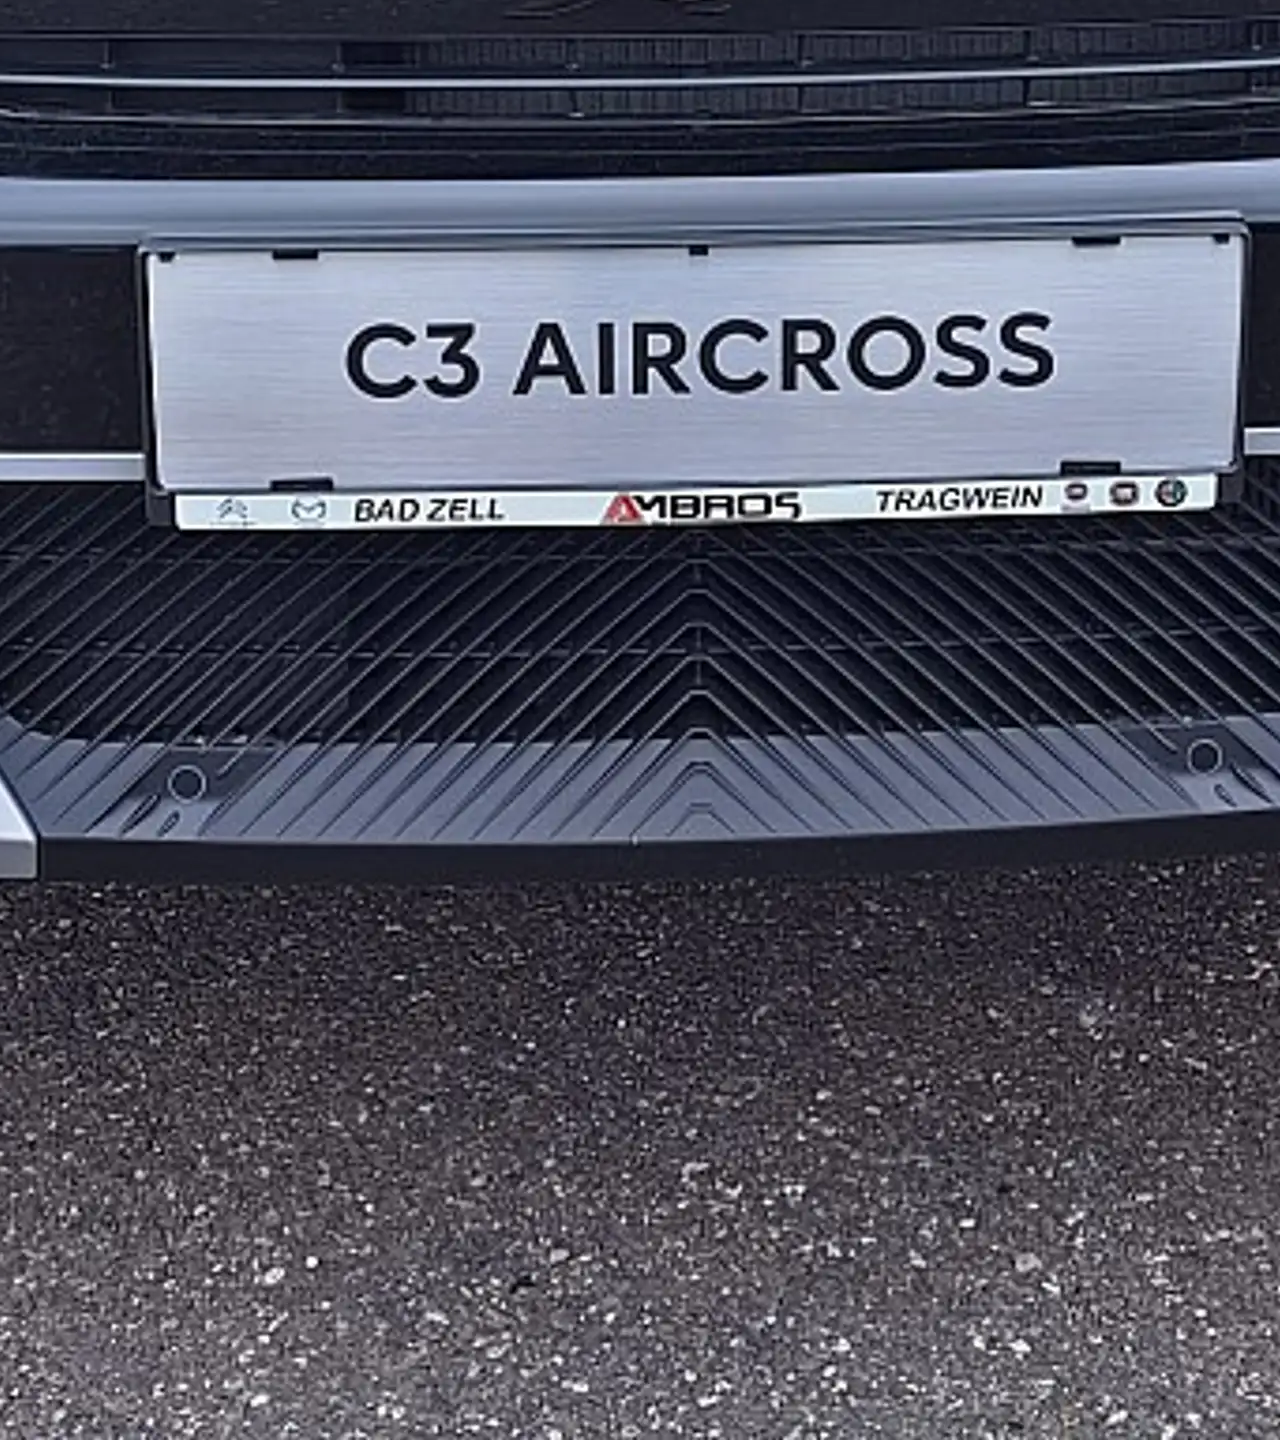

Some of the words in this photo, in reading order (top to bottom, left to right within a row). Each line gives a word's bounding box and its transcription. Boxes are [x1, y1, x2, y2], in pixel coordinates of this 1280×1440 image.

[347, 323, 479, 398] C3
[513, 313, 1053, 395] AIRCROSS
[355, 499, 419, 522] BAD
[427, 499, 502, 521] ZELL
[601, 491, 802, 524] AMBROS
[876, 485, 1043, 513] TRAGWEIN
